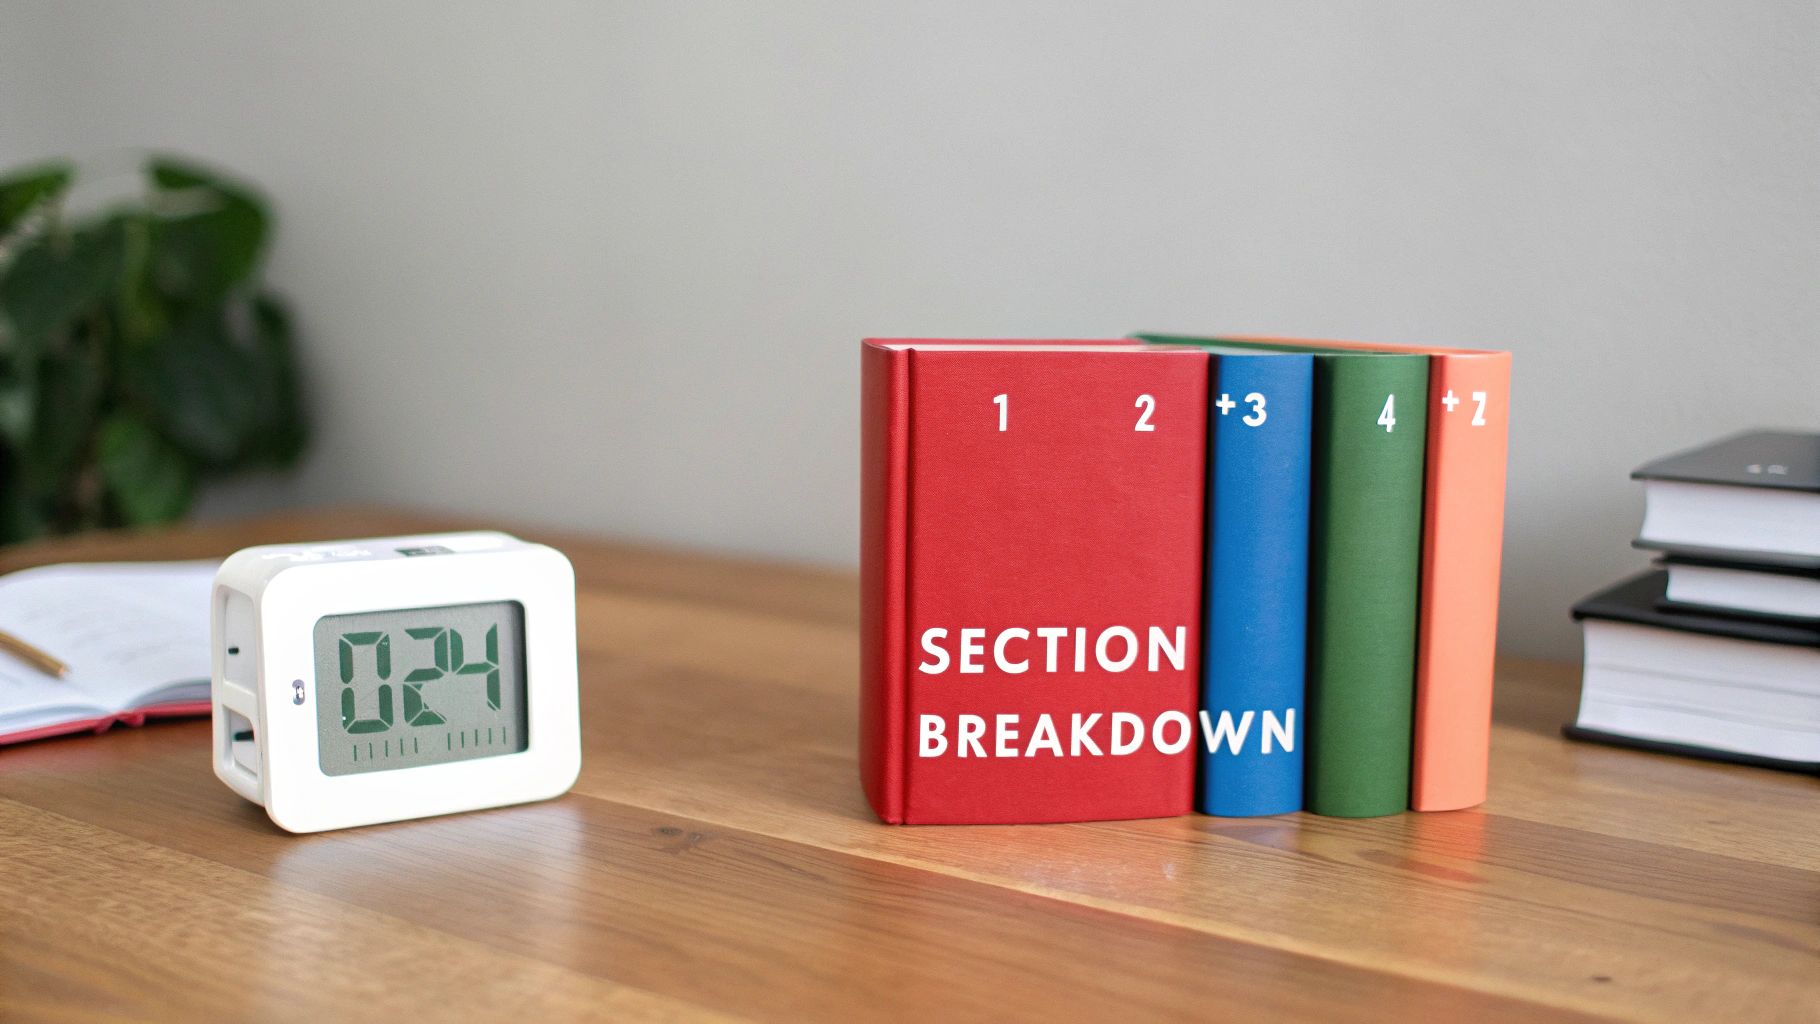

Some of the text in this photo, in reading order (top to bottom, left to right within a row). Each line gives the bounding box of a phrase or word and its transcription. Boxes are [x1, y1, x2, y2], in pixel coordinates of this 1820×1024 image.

[992, 393, 1156, 432] 1 2
[1377, 393, 1396, 433] 4
[918, 625, 1188, 675] SECTION
[918, 708, 1296, 759] BREAKDOWN
